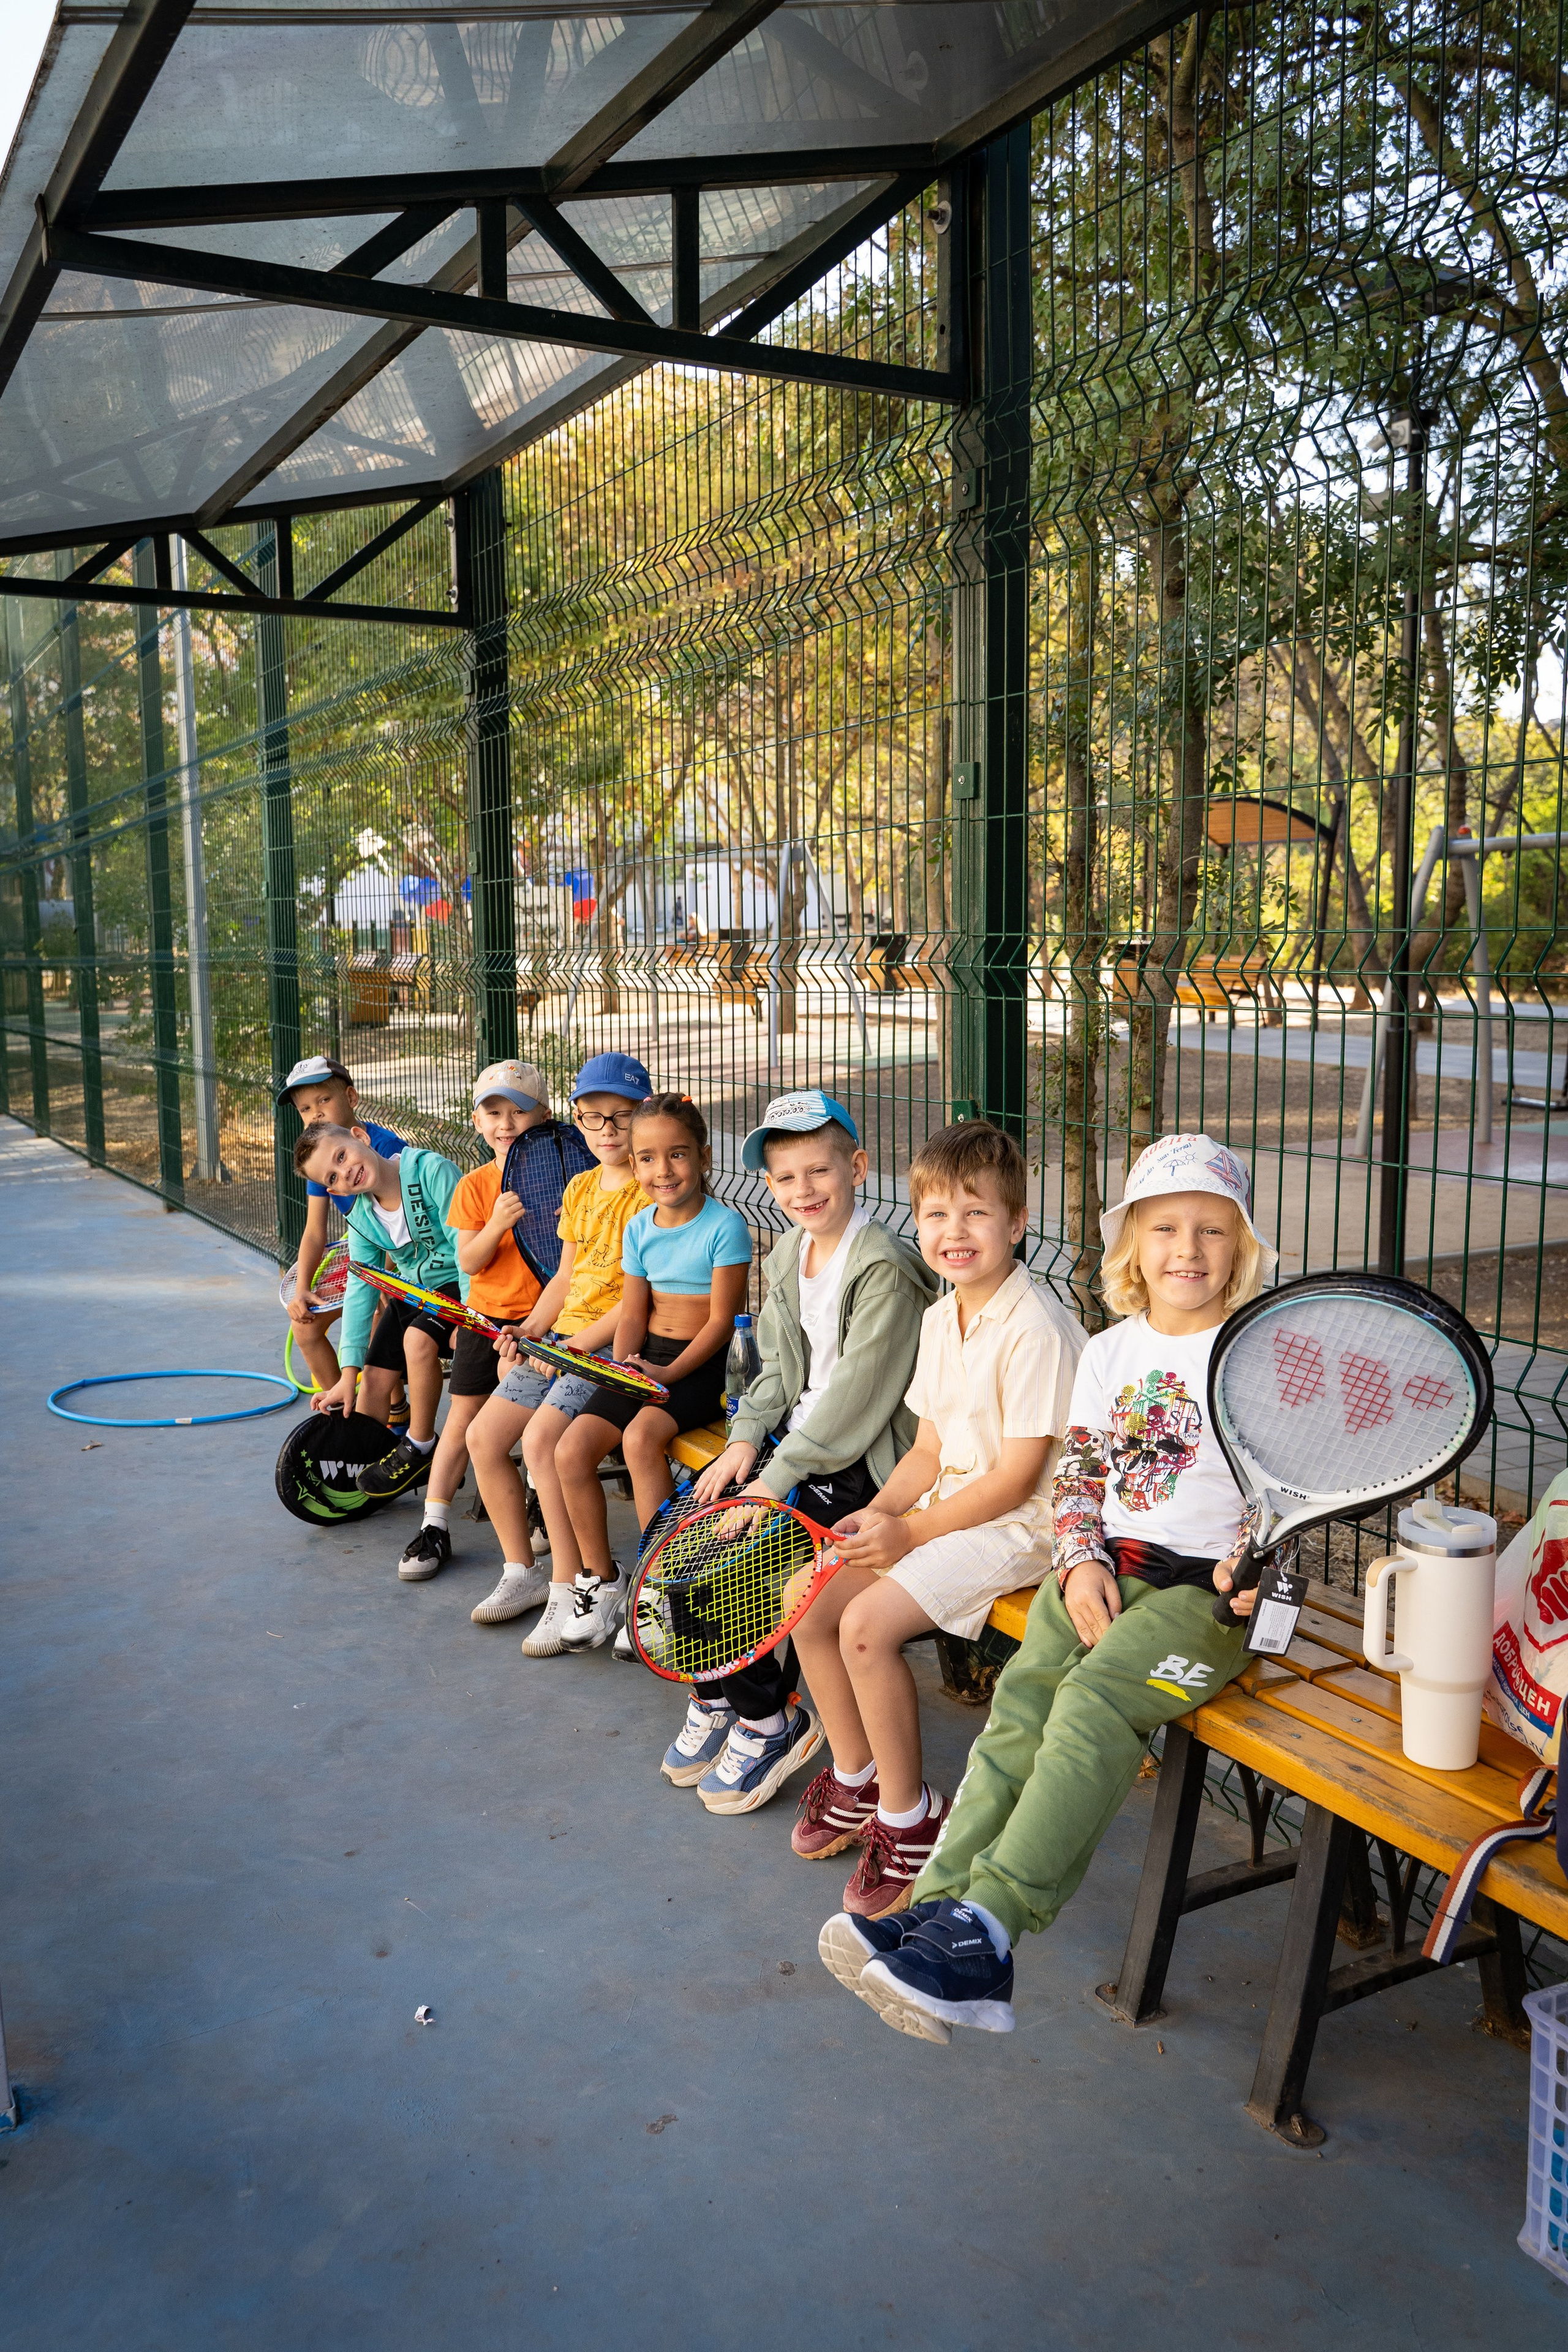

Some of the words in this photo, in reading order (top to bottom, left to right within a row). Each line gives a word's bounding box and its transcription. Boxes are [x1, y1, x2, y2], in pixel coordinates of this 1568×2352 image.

[625, 1072, 640, 1085] EA7
[809, 1484, 832, 1505] DEMIX
[1280, 1486, 1307, 1500] WISH
[1272, 1591, 1292, 1602] WISH
[1150, 1654, 1215, 1687] BE
[1518, 1701, 1531, 1720] ЦЕН
[954, 1907, 973, 1923] DEMIX
[958, 1938, 982, 1947] DEMIX
